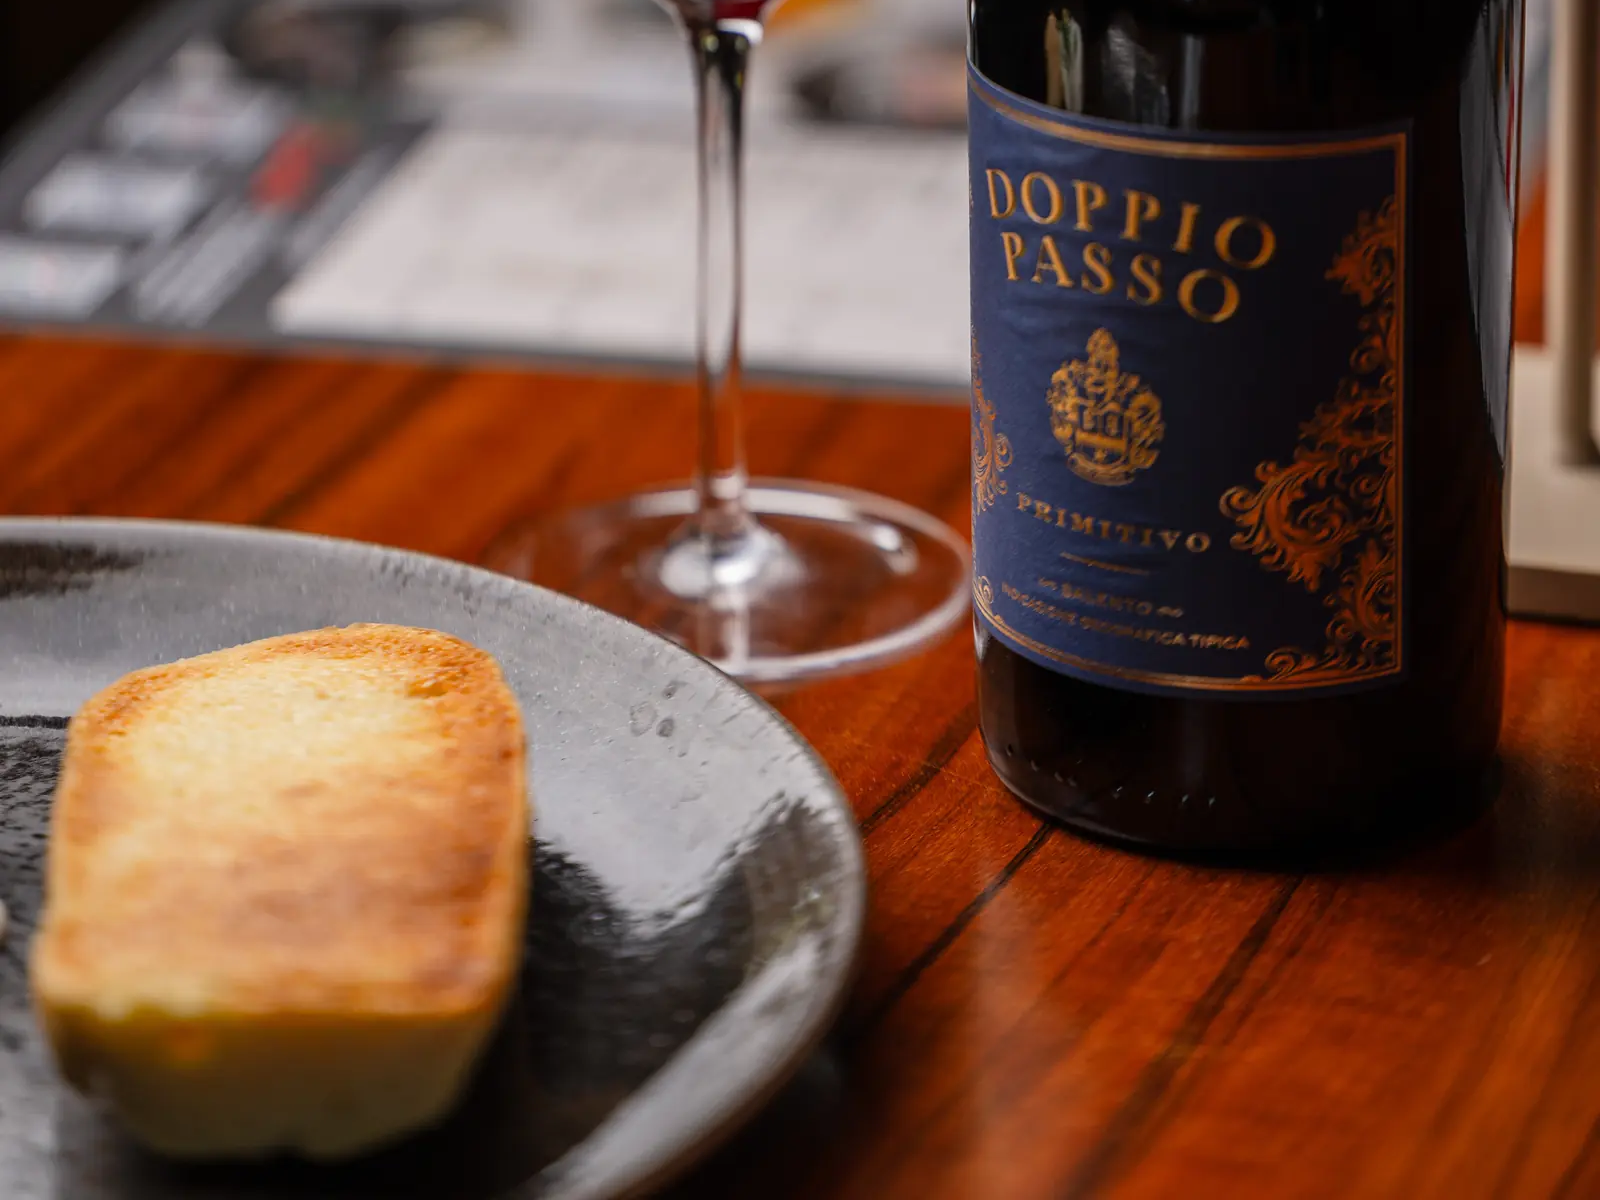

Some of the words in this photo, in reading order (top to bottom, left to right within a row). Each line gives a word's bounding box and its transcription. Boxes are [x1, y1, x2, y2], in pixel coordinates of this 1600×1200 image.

[985, 168, 1276, 270] DOPPIO
[1000, 231, 1241, 324] PASSO
[1016, 492, 1211, 553] PRIMITIVO
